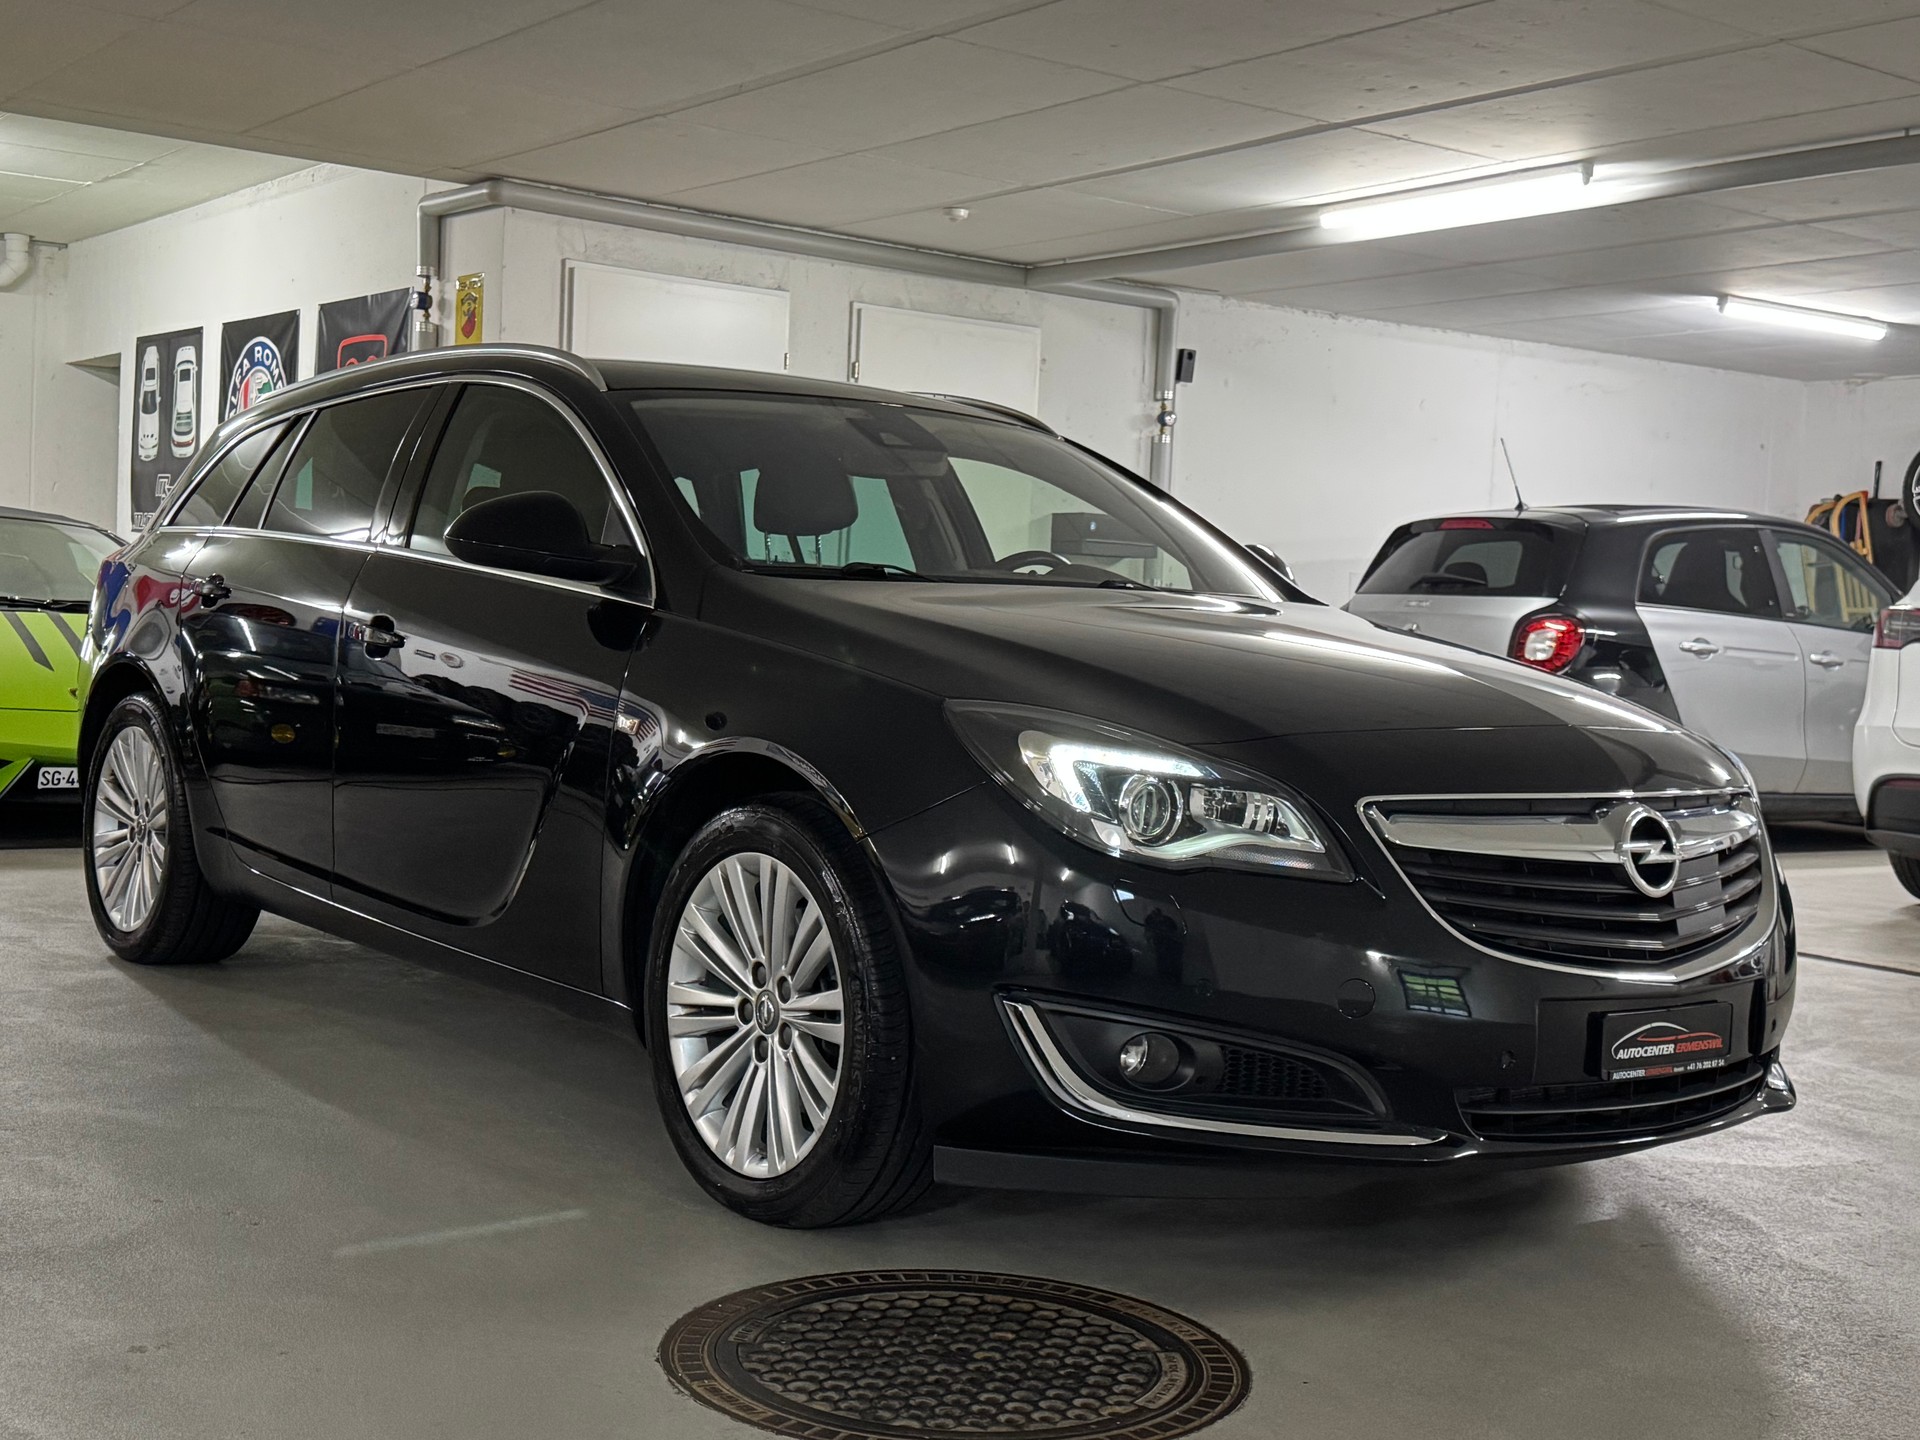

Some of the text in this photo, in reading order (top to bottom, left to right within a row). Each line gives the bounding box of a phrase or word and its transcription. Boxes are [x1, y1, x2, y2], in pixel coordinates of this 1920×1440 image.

[254, 345, 284, 389] ROM
[1616, 1038, 1723, 1060] AUTOCENTER ERMENSWIL
[1612, 1069, 1646, 1080] AUTOCENTER
